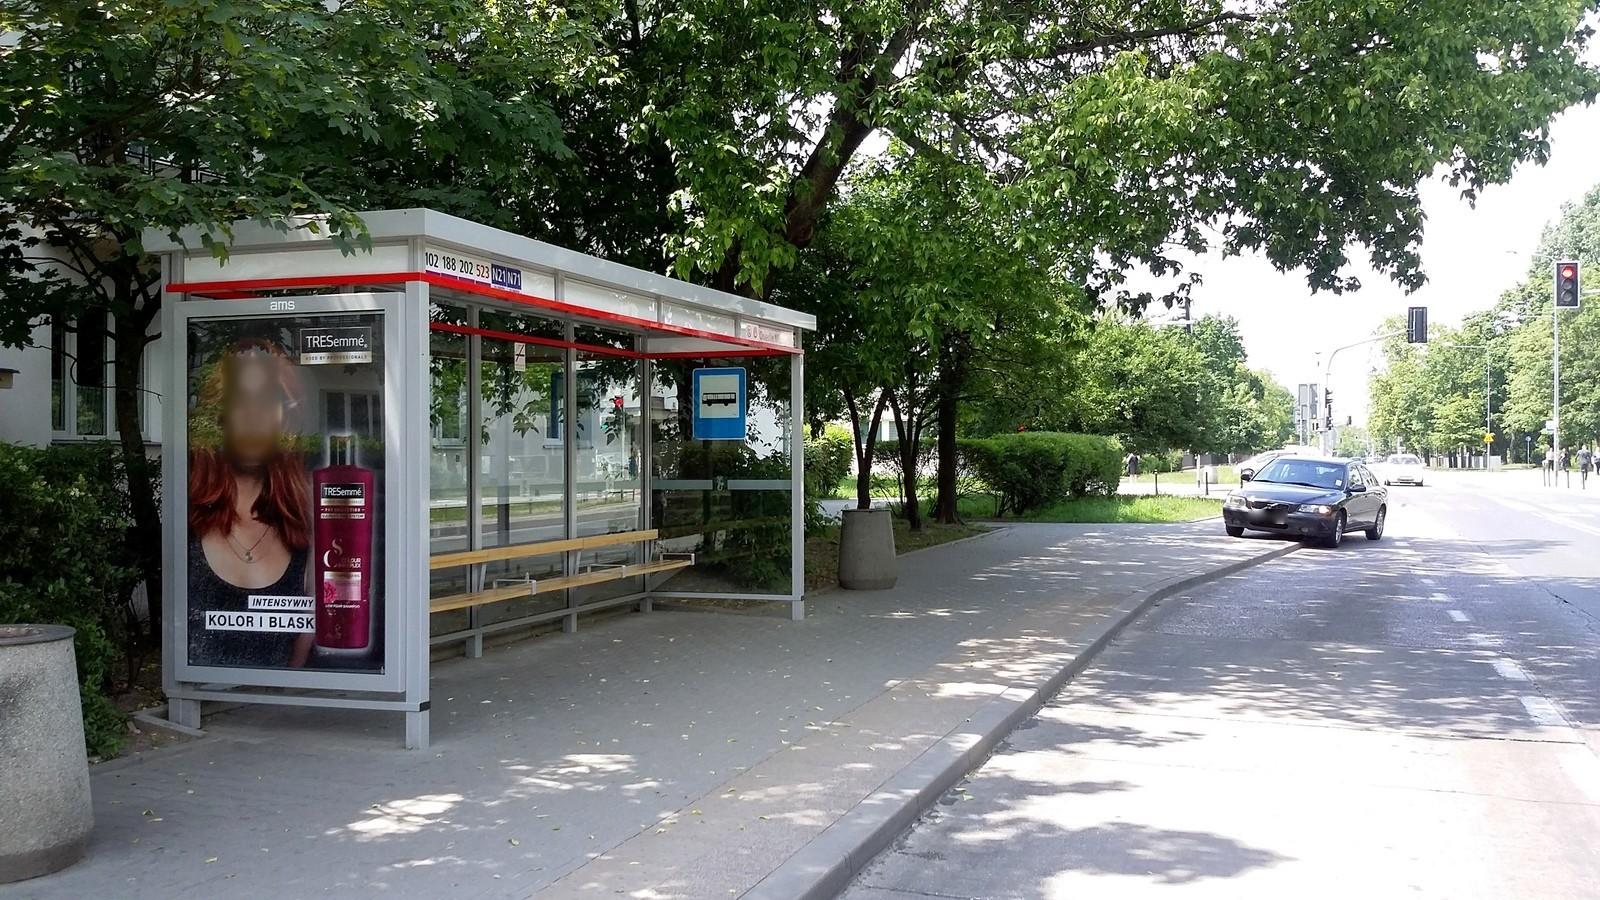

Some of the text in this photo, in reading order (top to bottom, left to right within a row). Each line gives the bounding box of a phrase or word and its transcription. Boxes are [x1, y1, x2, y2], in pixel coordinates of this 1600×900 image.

[425, 252, 521, 286] 102 188 202 523 N21 N71
[270, 300, 296, 310] ams
[252, 598, 314, 608] INTENSYWNY
[208, 614, 315, 629] KOLOR I BLASK
